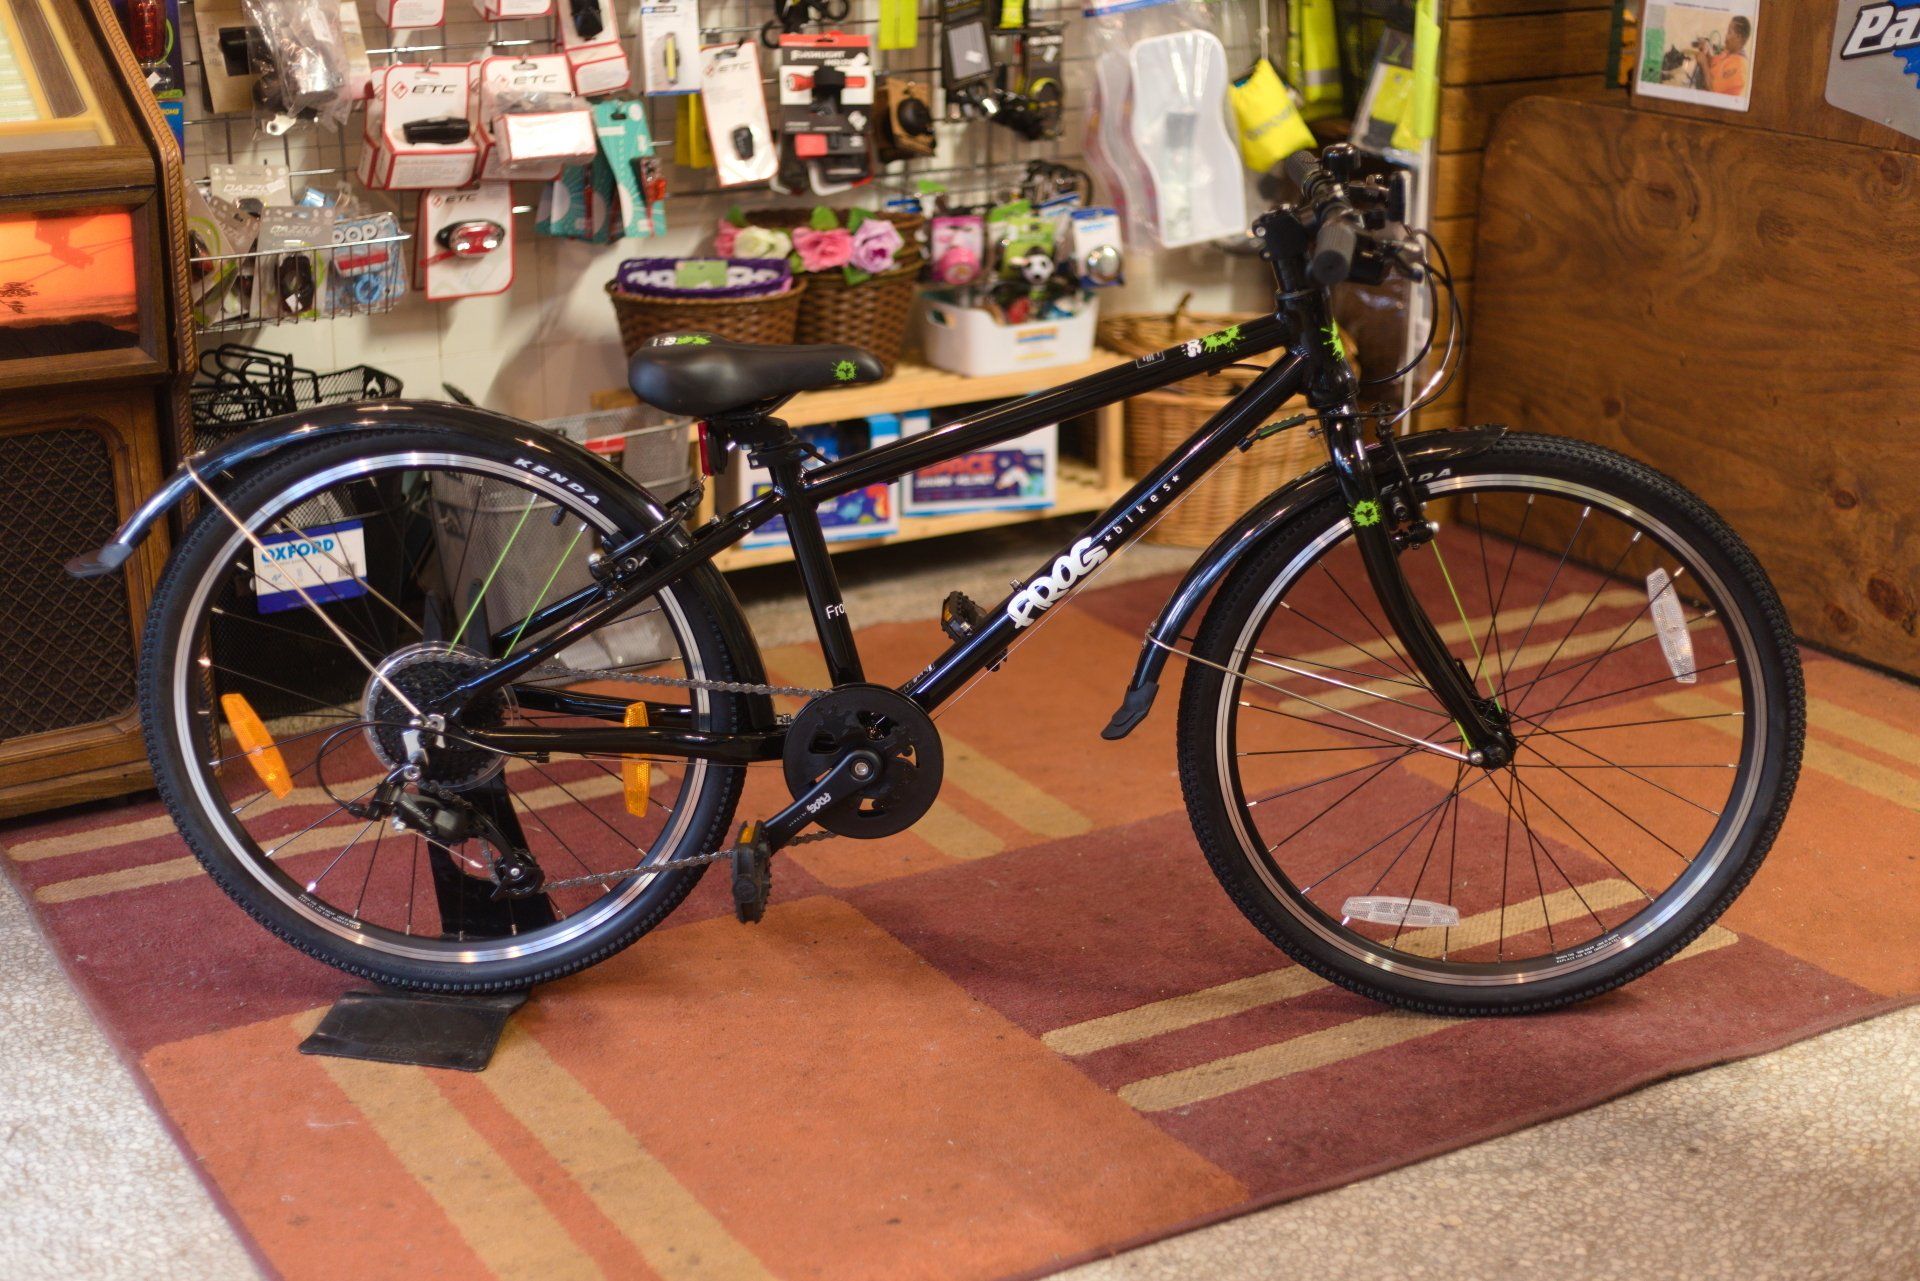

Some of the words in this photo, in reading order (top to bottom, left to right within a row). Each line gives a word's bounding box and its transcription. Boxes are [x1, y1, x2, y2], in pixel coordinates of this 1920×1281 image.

[514, 74, 558, 85] ETC
[412, 84, 457, 94] ETC
[446, 193, 478, 203] ETC
[514, 458, 600, 505] KENDA
[261, 538, 335, 563] OXFORD
[1006, 537, 1108, 629] FROG
[1113, 482, 1172, 535] bikes
